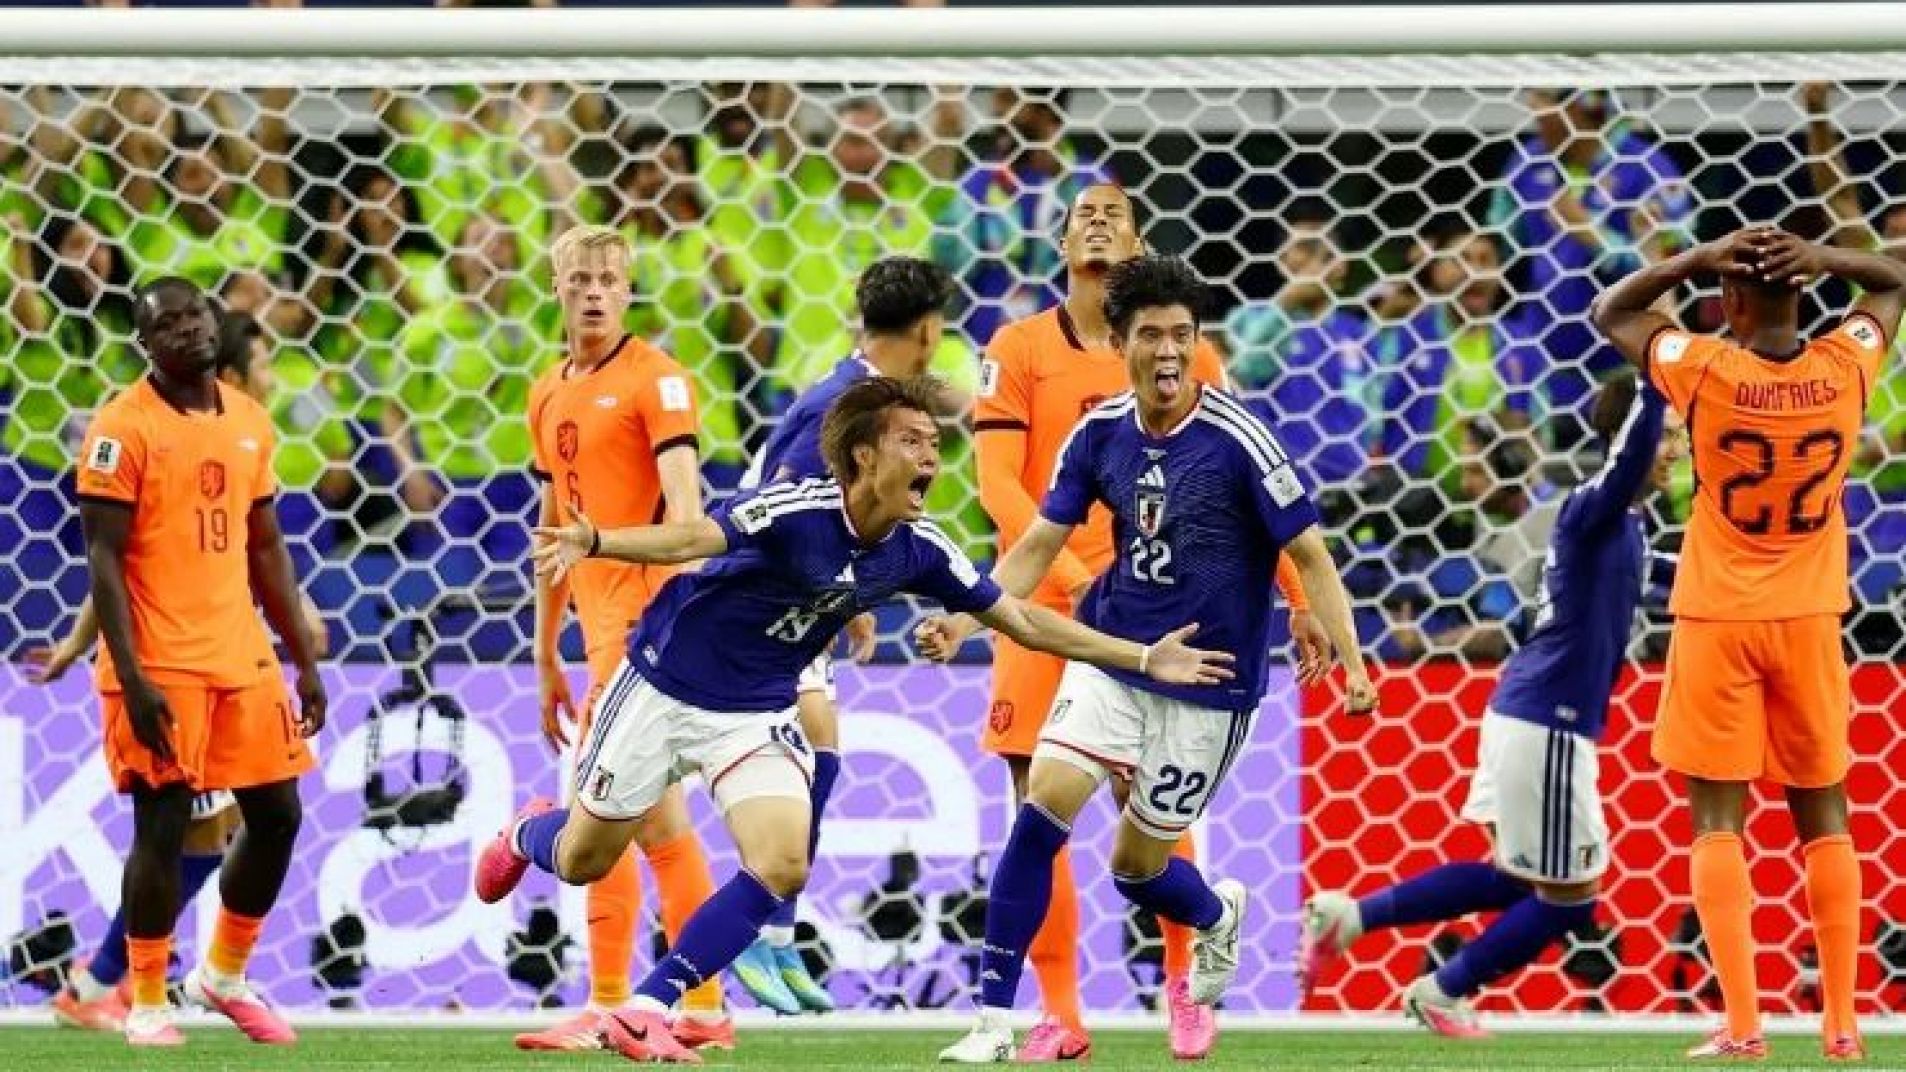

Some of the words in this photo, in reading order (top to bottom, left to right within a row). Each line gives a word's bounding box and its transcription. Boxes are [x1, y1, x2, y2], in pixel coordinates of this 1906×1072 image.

[1735, 379, 1838, 411] DUMFRIES
[1717, 429, 1844, 535] 22
[195, 508, 228, 553] 19
[1130, 537, 1175, 585] 22
[1149, 764, 1207, 815] 22
